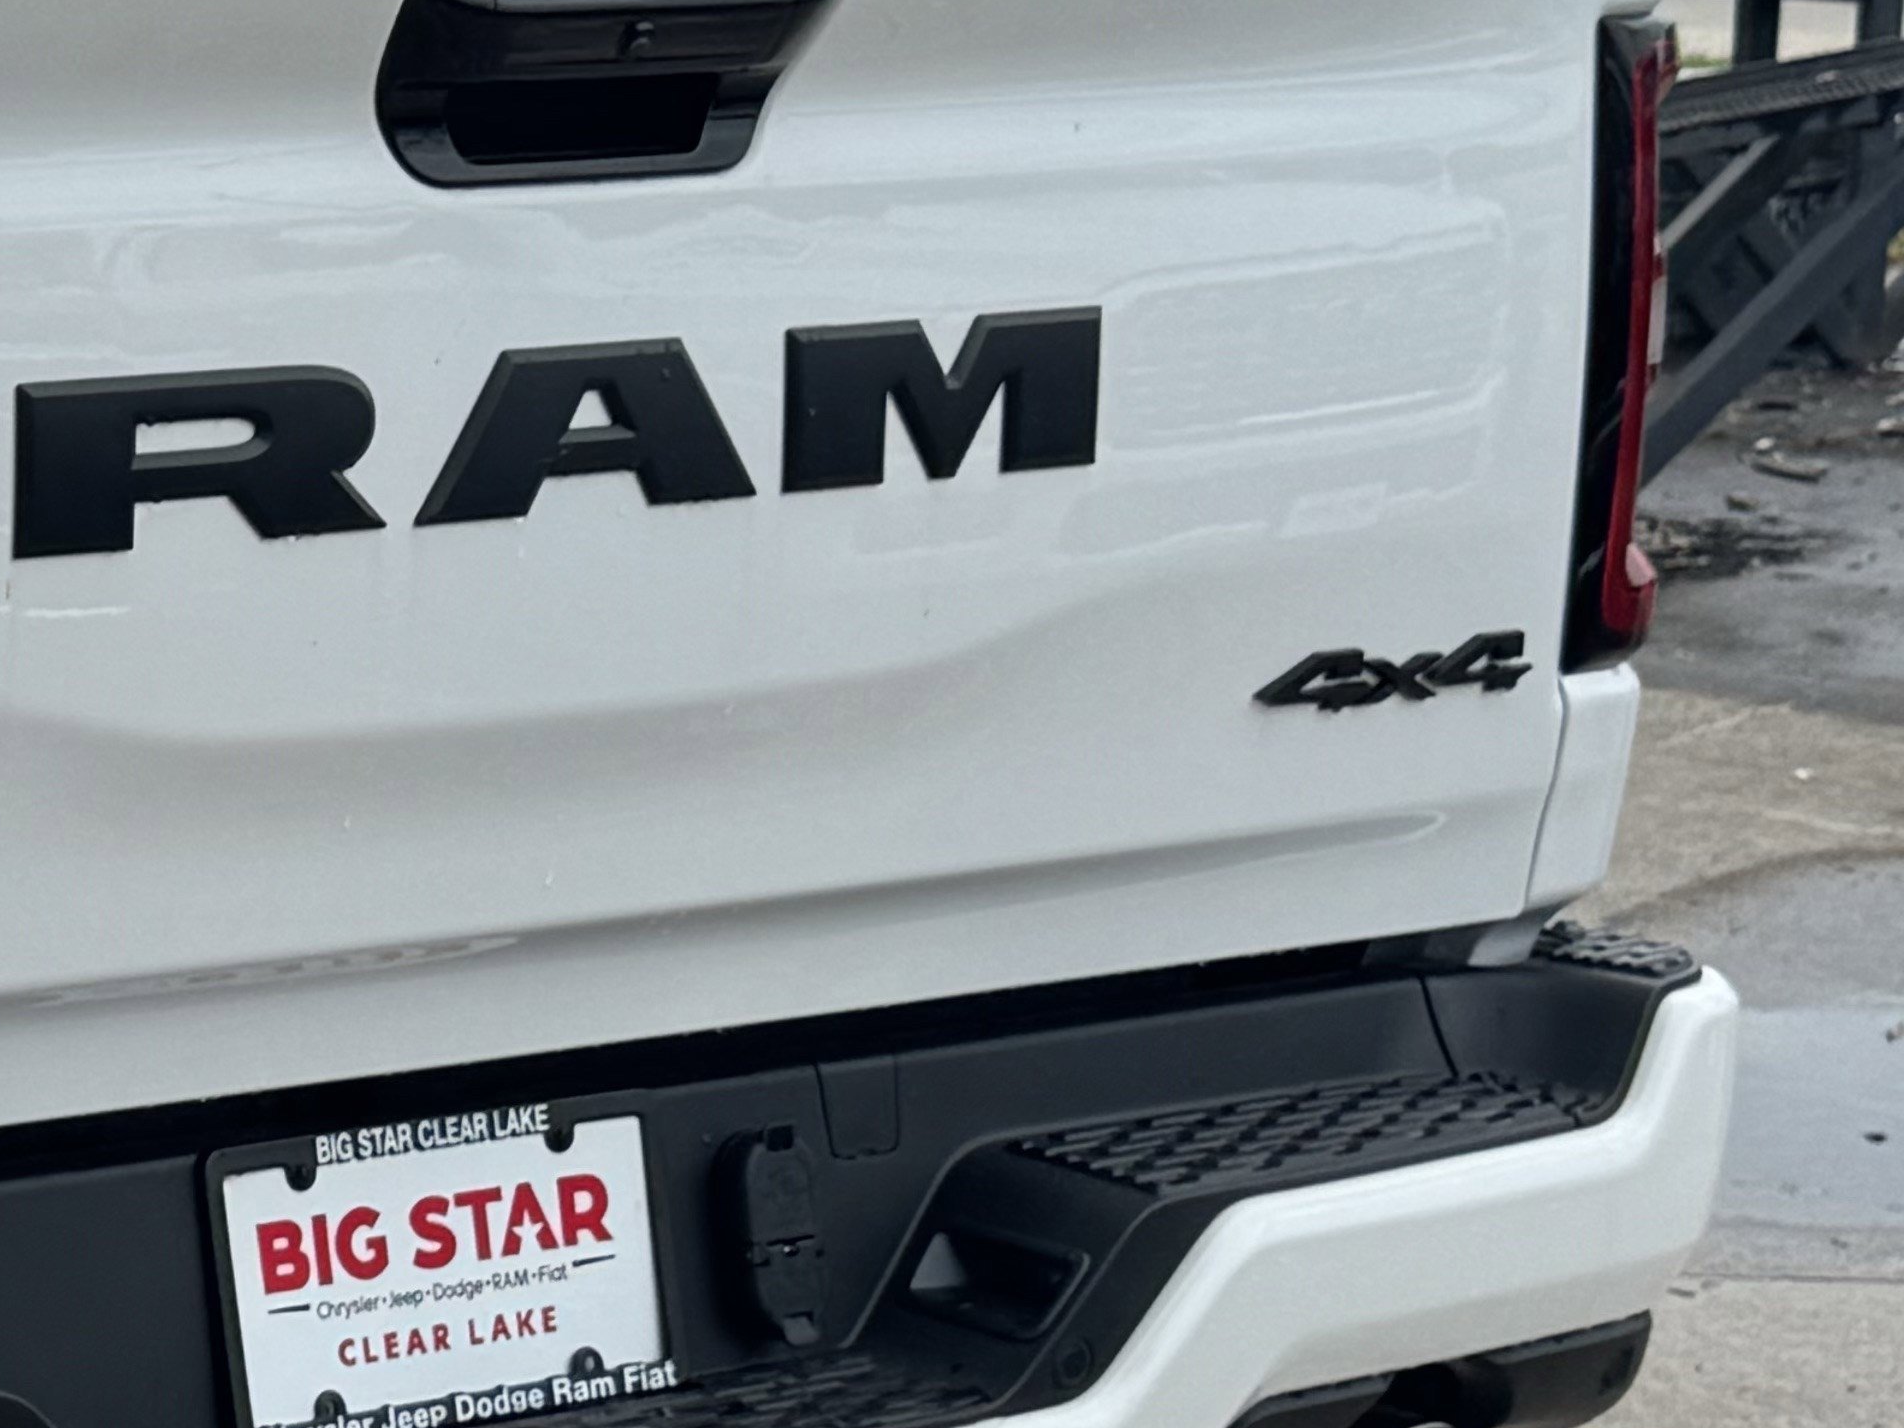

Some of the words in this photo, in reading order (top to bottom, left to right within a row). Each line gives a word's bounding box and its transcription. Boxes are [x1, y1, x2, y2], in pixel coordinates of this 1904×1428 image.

[12, 304, 1103, 559] RAM
[315, 1131, 353, 1165] BIG
[357, 1122, 414, 1159] STAR
[417, 1110, 489, 1149] CLEAR
[491, 1103, 551, 1139] LAKE
[256, 1206, 388, 1295] BIG
[408, 1174, 613, 1269] STAR
[316, 1294, 380, 1321] Chrysler
[432, 1279, 484, 1303] Dodge
[492, 1269, 531, 1291] RAM
[537, 1263, 568, 1284] Fiat
[337, 1323, 452, 1367] CLEAR
[468, 1305, 558, 1346] LAKE
[455, 1385, 546, 1423] Dodge
[552, 1370, 617, 1406] Ram
[623, 1359, 680, 1394] Fiat
